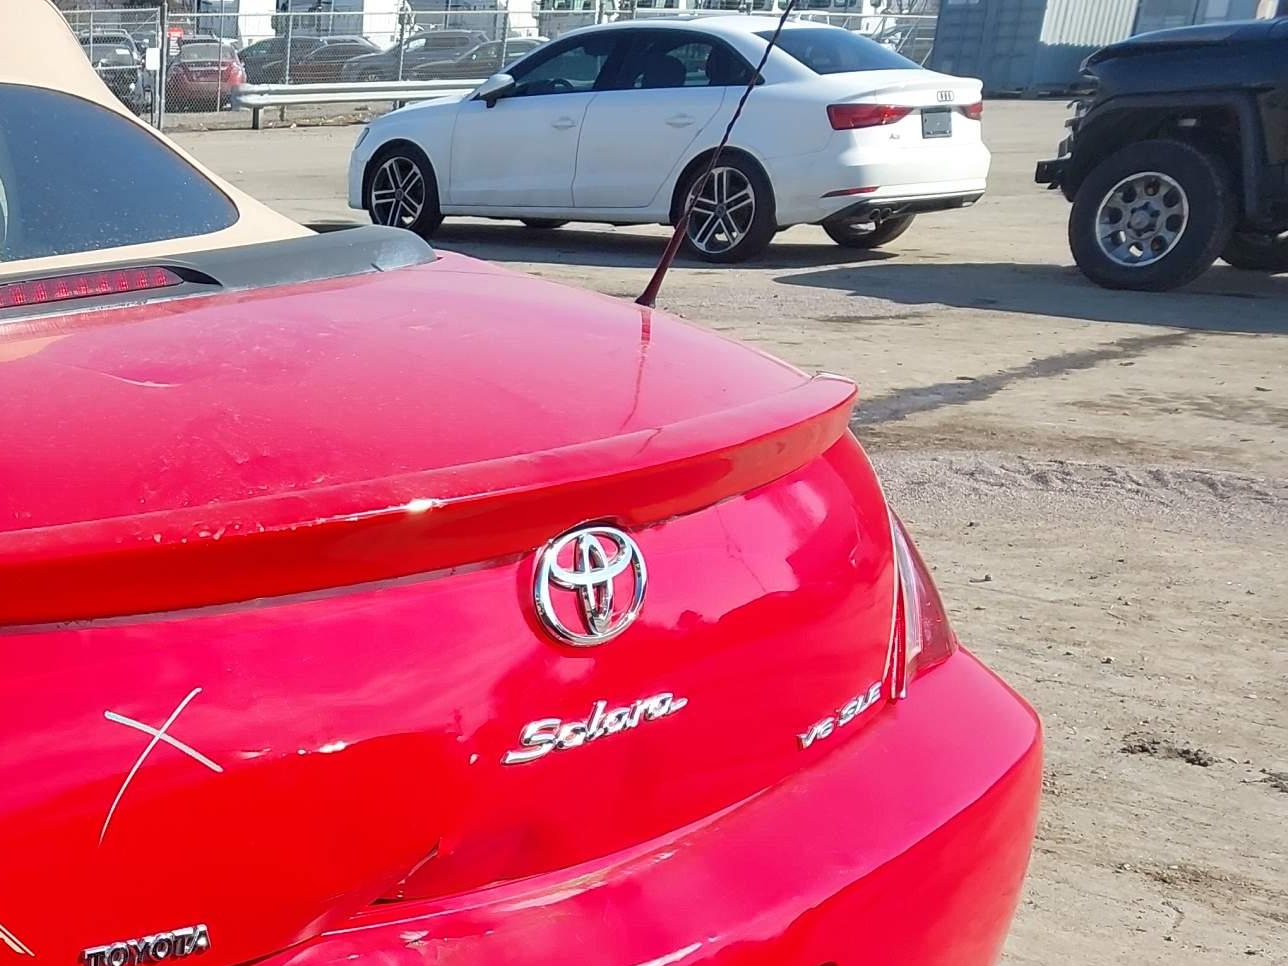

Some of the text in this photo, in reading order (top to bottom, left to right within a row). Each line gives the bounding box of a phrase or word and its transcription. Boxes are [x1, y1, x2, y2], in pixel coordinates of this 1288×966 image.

[500, 692, 688, 765] Solara
[796, 681, 882, 749] V6 SLE
